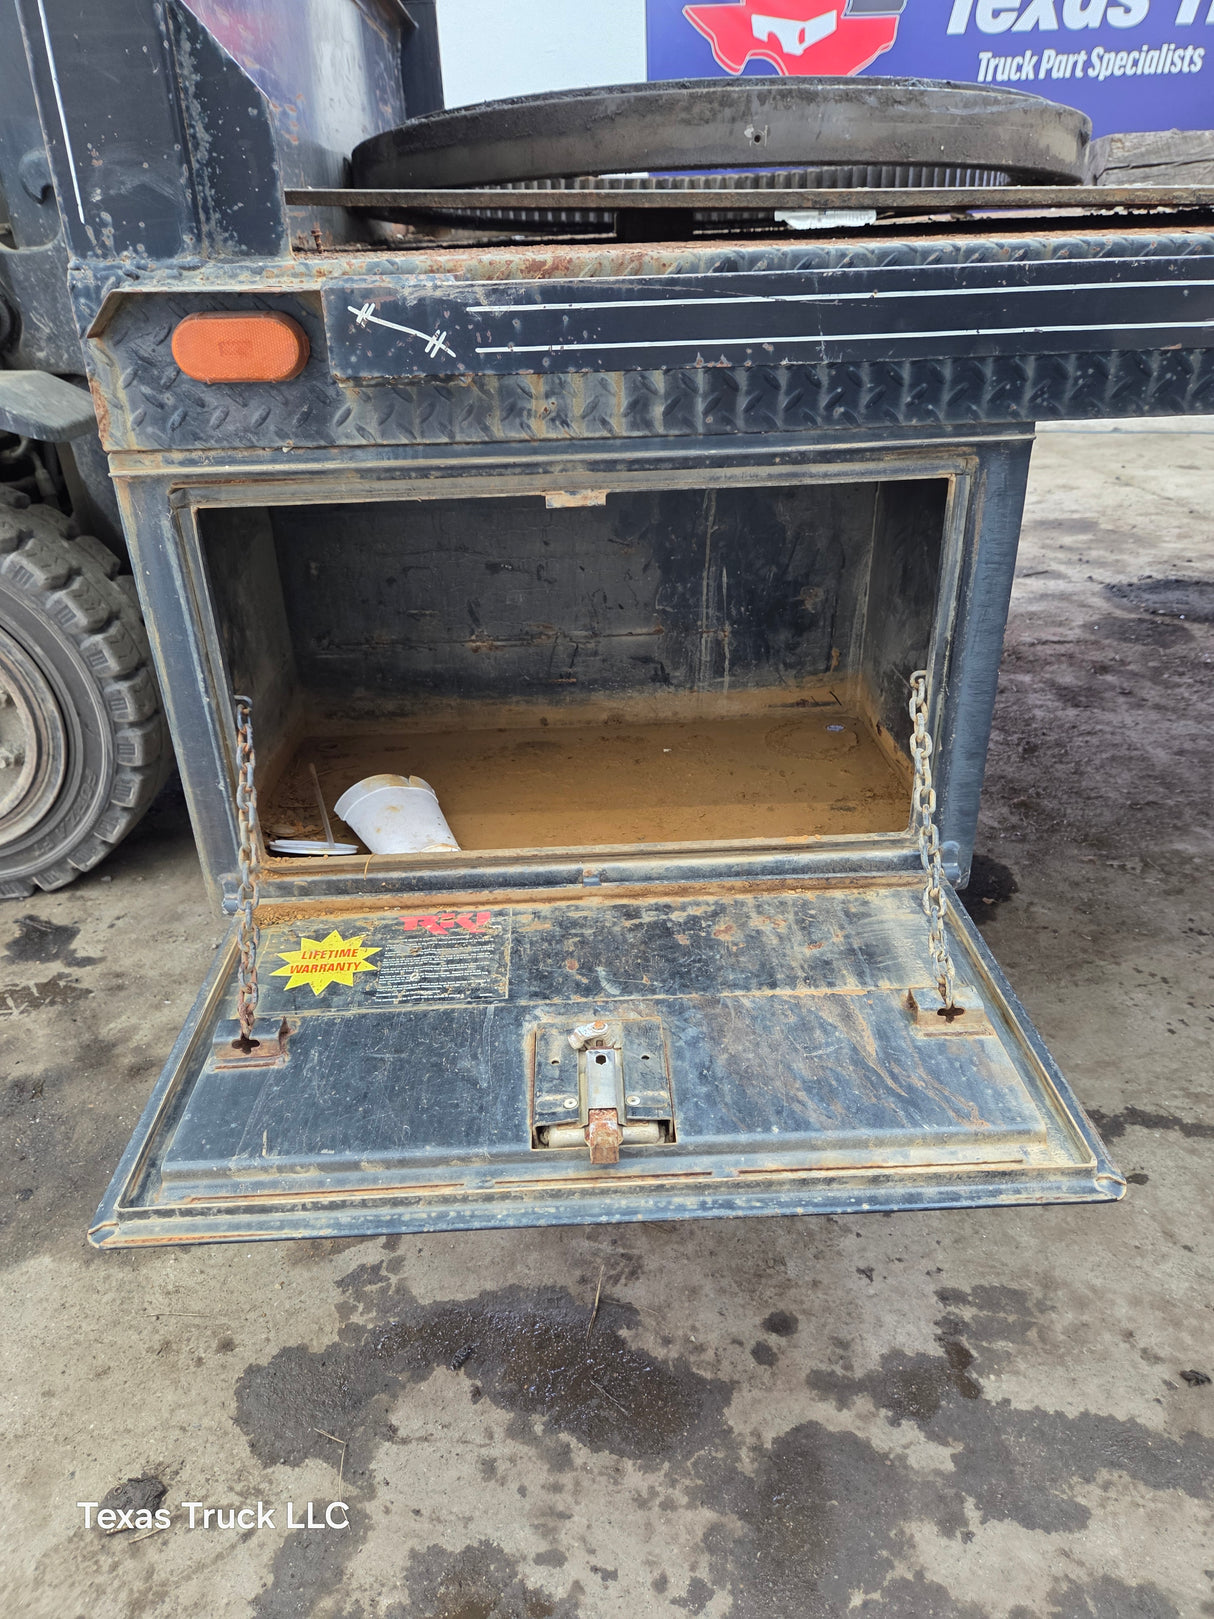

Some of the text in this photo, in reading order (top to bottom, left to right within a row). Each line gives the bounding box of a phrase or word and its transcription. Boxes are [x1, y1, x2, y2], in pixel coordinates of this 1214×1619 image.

[977, 43, 1206, 82] Truck Part Specialists
[301, 948, 359, 960] LIFETIME
[289, 961, 362, 974] WARRANTY
